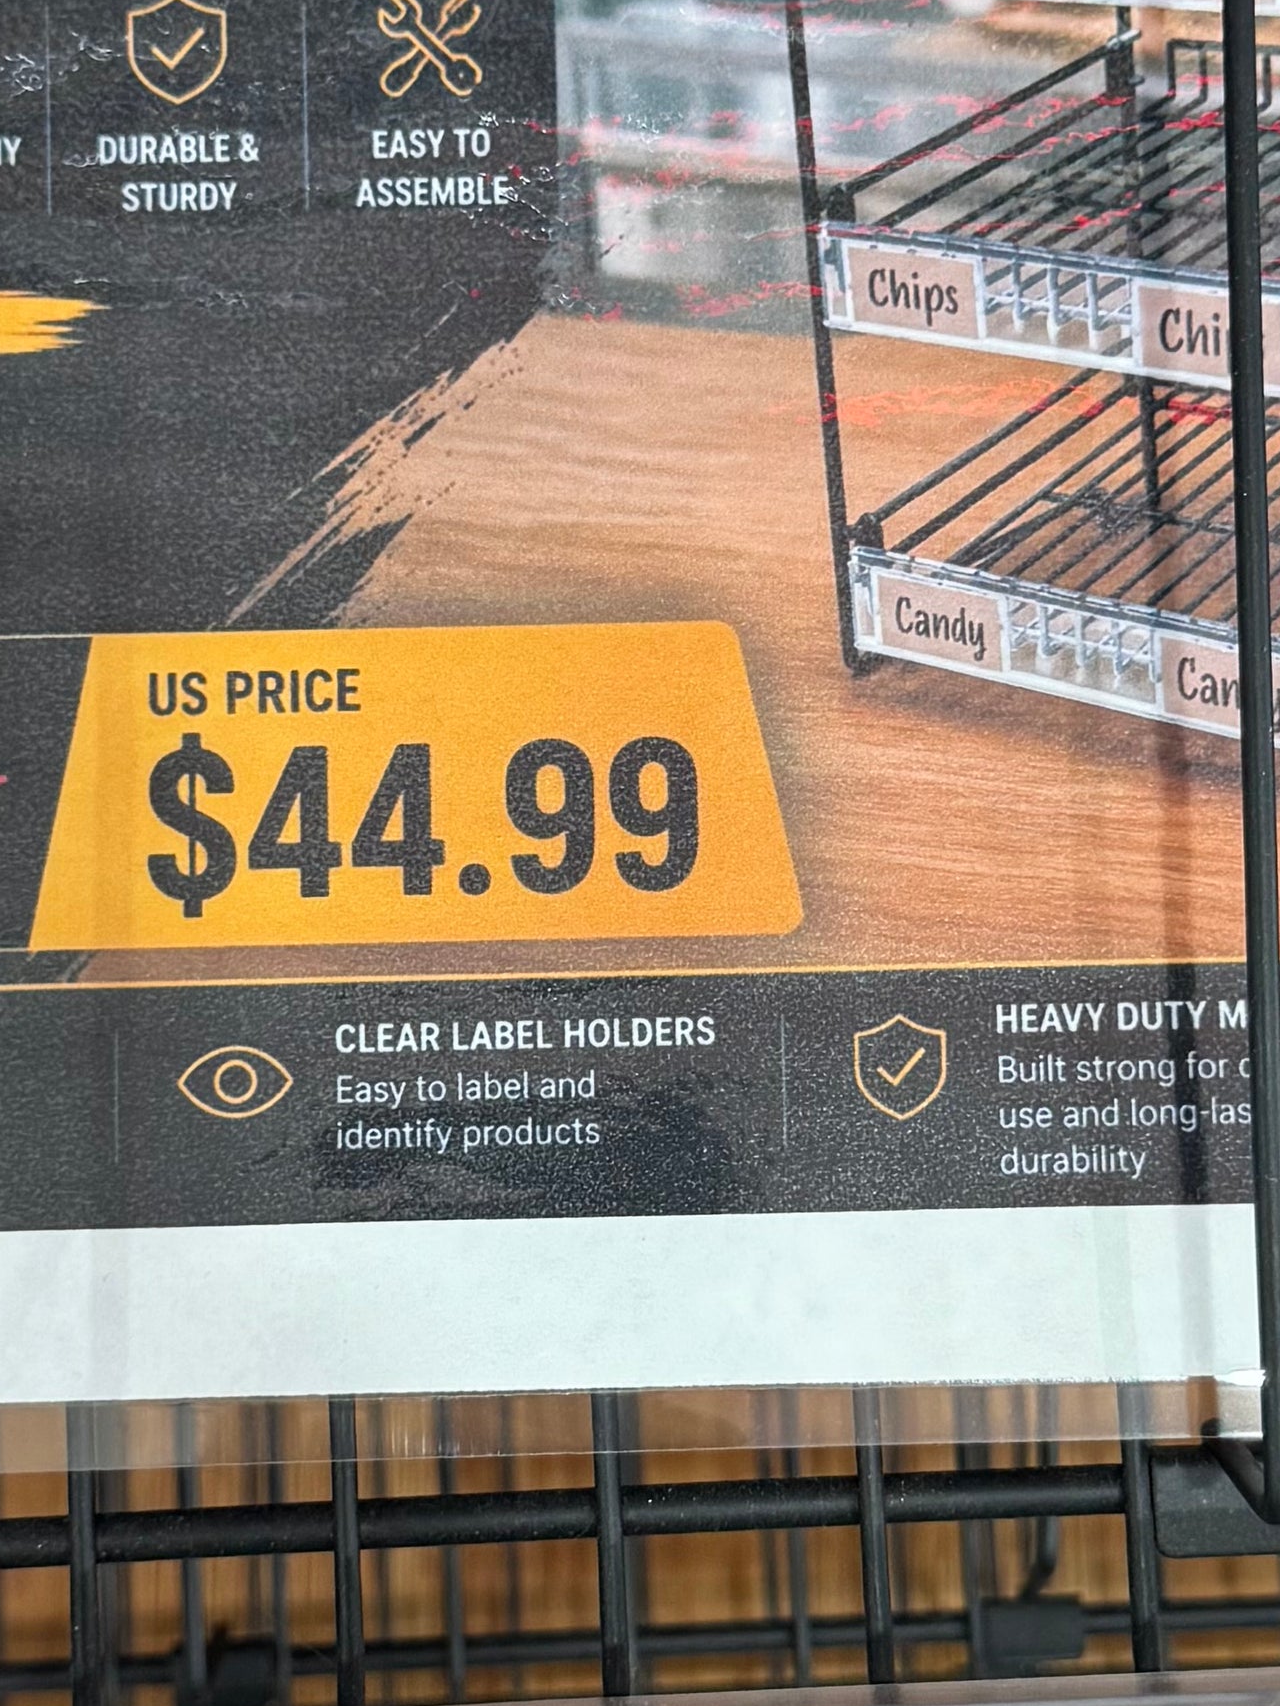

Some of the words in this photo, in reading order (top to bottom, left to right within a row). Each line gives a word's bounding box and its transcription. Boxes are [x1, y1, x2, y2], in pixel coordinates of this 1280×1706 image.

[98, 135, 230, 165] DURABLE
[239, 134, 260, 163] &
[372, 130, 444, 159] EASY
[453, 128, 491, 158] TO
[121, 182, 237, 212] STURDY
[356, 177, 508, 208] ASSEMBLE
[867, 266, 961, 326] Chips
[1158, 306, 1232, 373] Chi
[894, 596, 985, 662] Candy
[148, 671, 207, 717] US
[226, 668, 361, 714] PRICE
[147, 732, 698, 918] $44.99
[335, 1022, 440, 1053] CLEAR
[452, 1020, 553, 1051] LABEL
[563, 1016, 716, 1048] HOLDERS
[995, 1002, 1105, 1034] HEAVY
[1117, 1000, 1206, 1032] DUTY
[998, 1055, 1066, 1084] Built
[1076, 1059, 1176, 1087] strong
[1187, 1051, 1229, 1080] for
[336, 1075, 406, 1109] Easy
[417, 1075, 447, 1102] to
[458, 1071, 529, 1101] label
[539, 1070, 596, 1099] and
[998, 1106, 1053, 1129] use
[1063, 1098, 1119, 1127] and
[336, 1119, 452, 1154] identify
[463, 1117, 600, 1154] products
[999, 1144, 1147, 1180] durability
